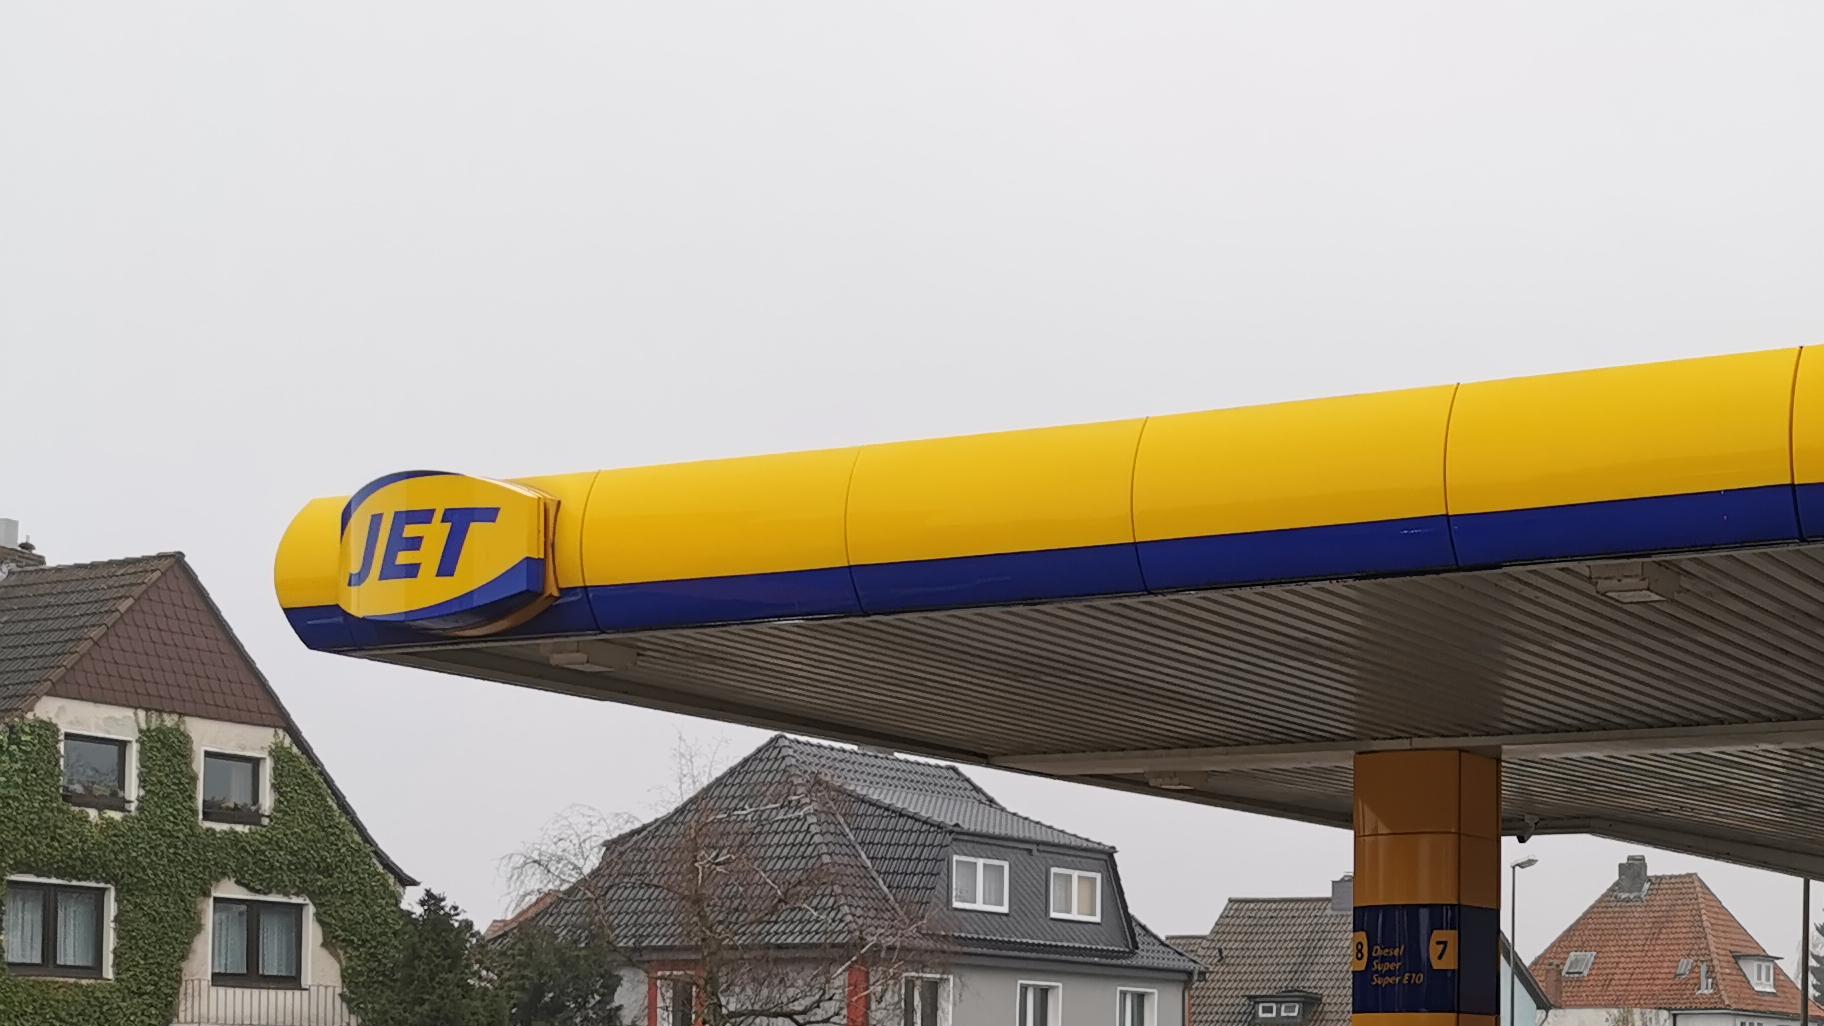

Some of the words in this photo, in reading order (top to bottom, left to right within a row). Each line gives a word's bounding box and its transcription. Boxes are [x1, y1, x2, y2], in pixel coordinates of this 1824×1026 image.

[348, 507, 500, 587] JET
[1355, 941, 1364, 960] 8
[1372, 944, 1405, 957] Diesel
[1435, 940, 1449, 960] 7
[1372, 961, 1402, 973] Super
[1371, 974, 1400, 987] Super
[1402, 973, 1423, 984] E10
